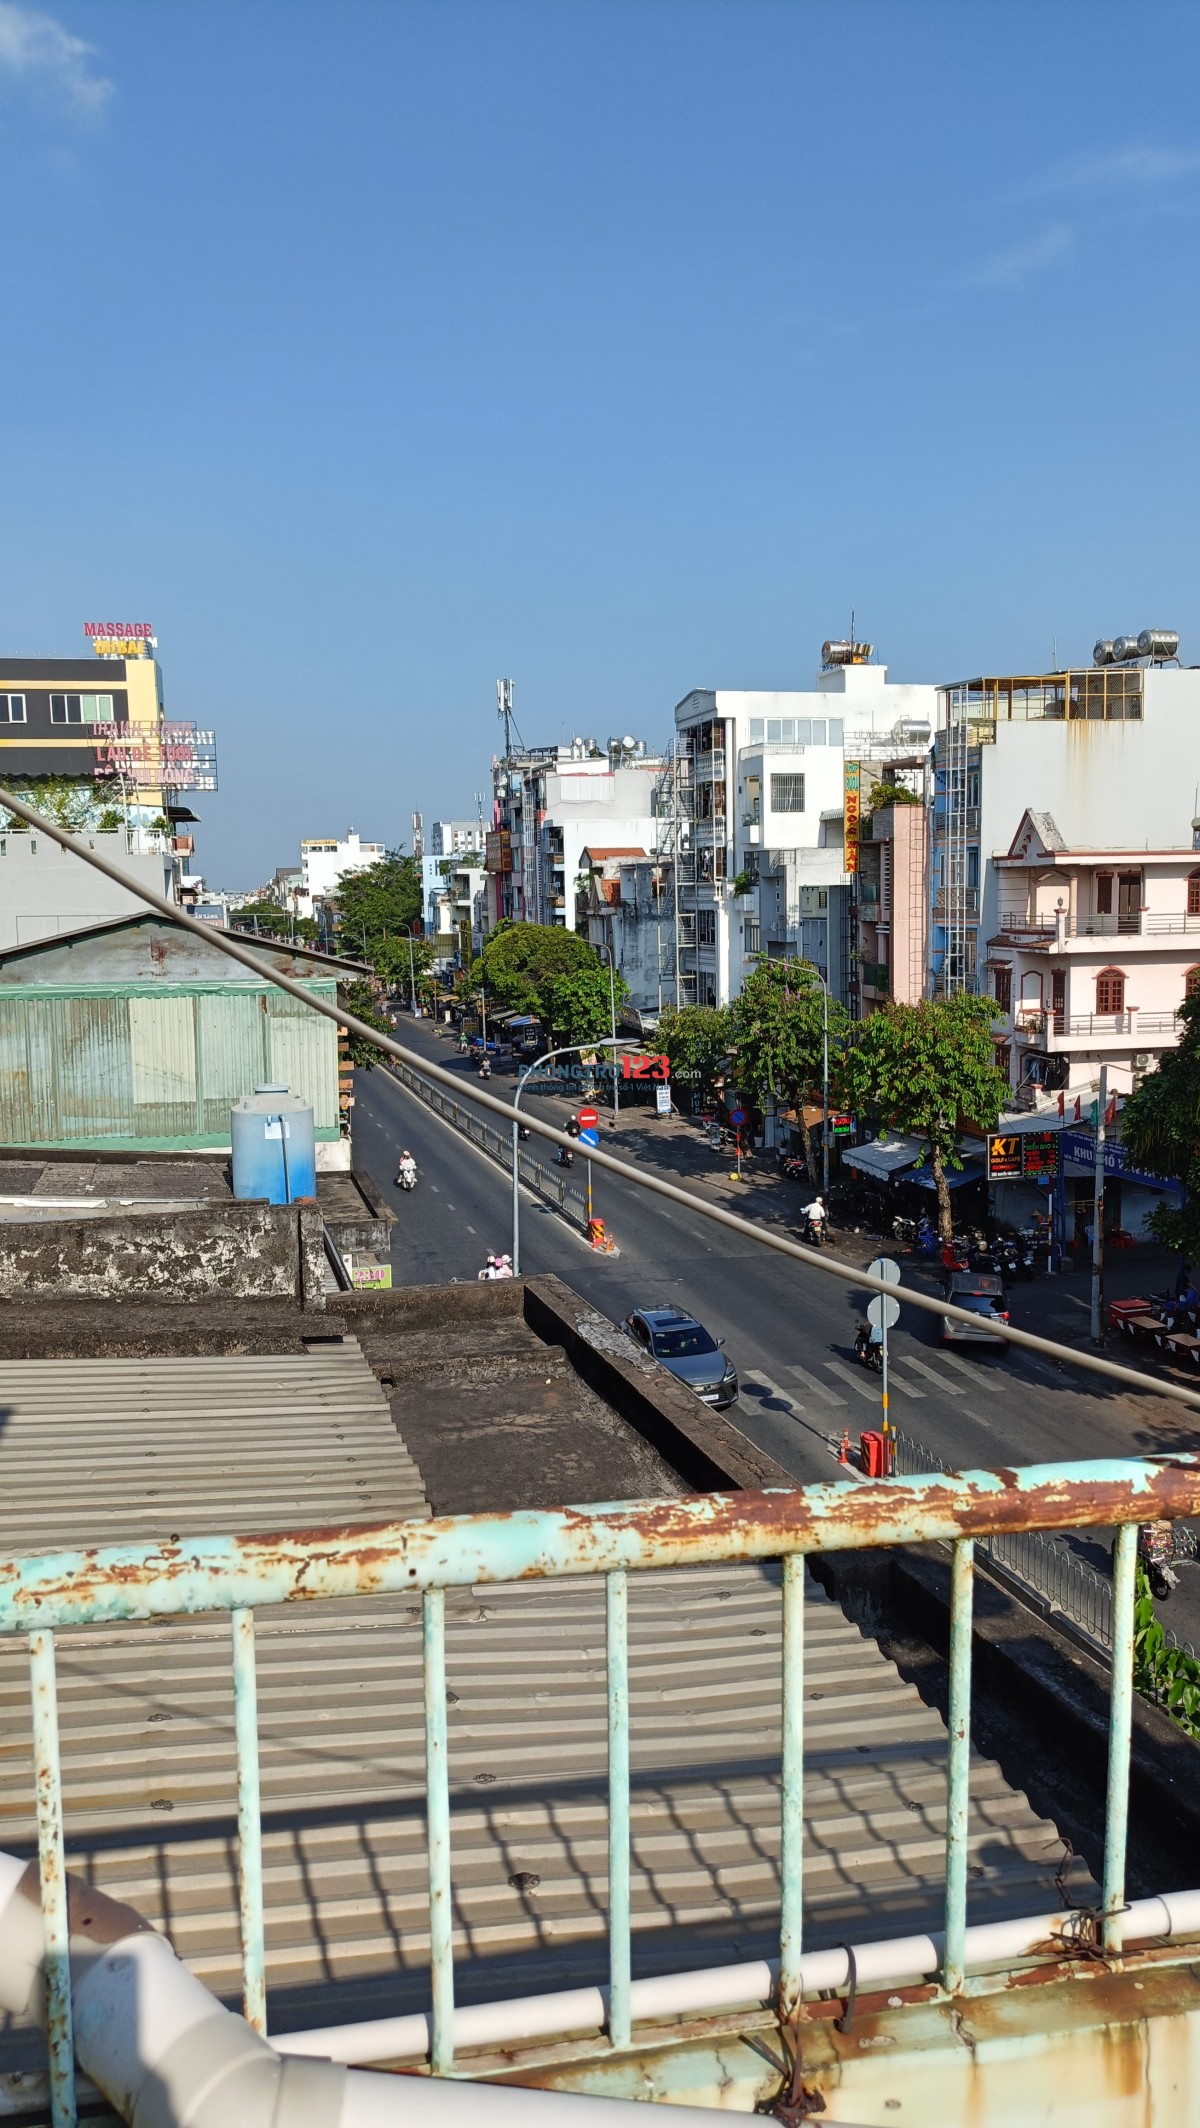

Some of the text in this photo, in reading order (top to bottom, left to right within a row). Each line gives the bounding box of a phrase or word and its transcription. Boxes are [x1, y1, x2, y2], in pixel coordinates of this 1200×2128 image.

[84, 622, 152, 636] MASSAGE
[95, 640, 144, 654] DUBAI
[991, 1137, 1020, 1156] KT
[1073, 1146, 1093, 1160] KHU
